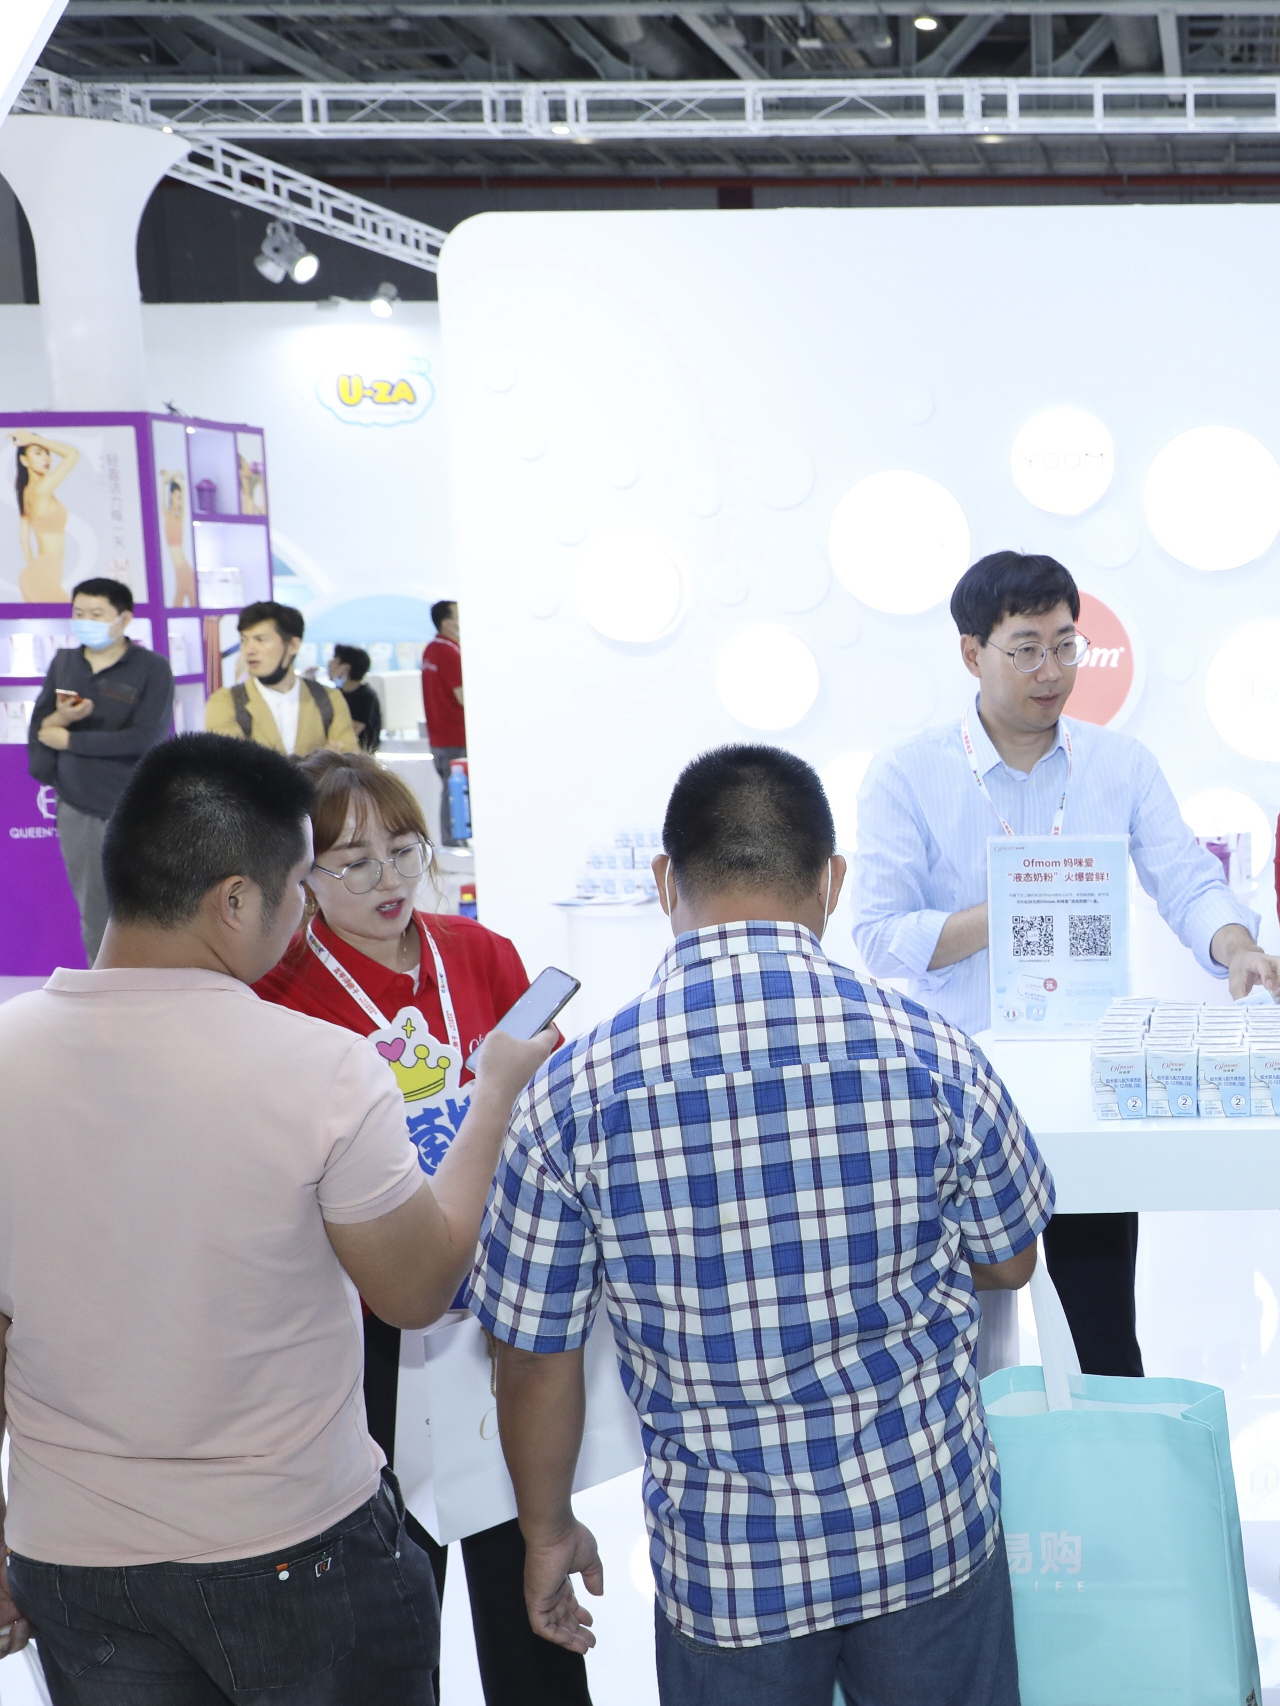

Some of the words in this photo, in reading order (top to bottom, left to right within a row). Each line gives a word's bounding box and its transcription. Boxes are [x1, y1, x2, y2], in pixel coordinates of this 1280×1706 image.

[337, 374, 416, 407] U-ZA
[1022, 859, 1061, 868] Ofmom
[1063, 857, 1094, 868] 妈咪爱
[1007, 872, 1058, 883] “液态奶粉”
[1064, 872, 1110, 882] 火爆尝鲜!
[1131, 1100, 1138, 1108] 2
[1182, 1097, 1188, 1106] 2
[1235, 1098, 1241, 1106] 2
[1004, 1530, 1082, 1575] 易购
